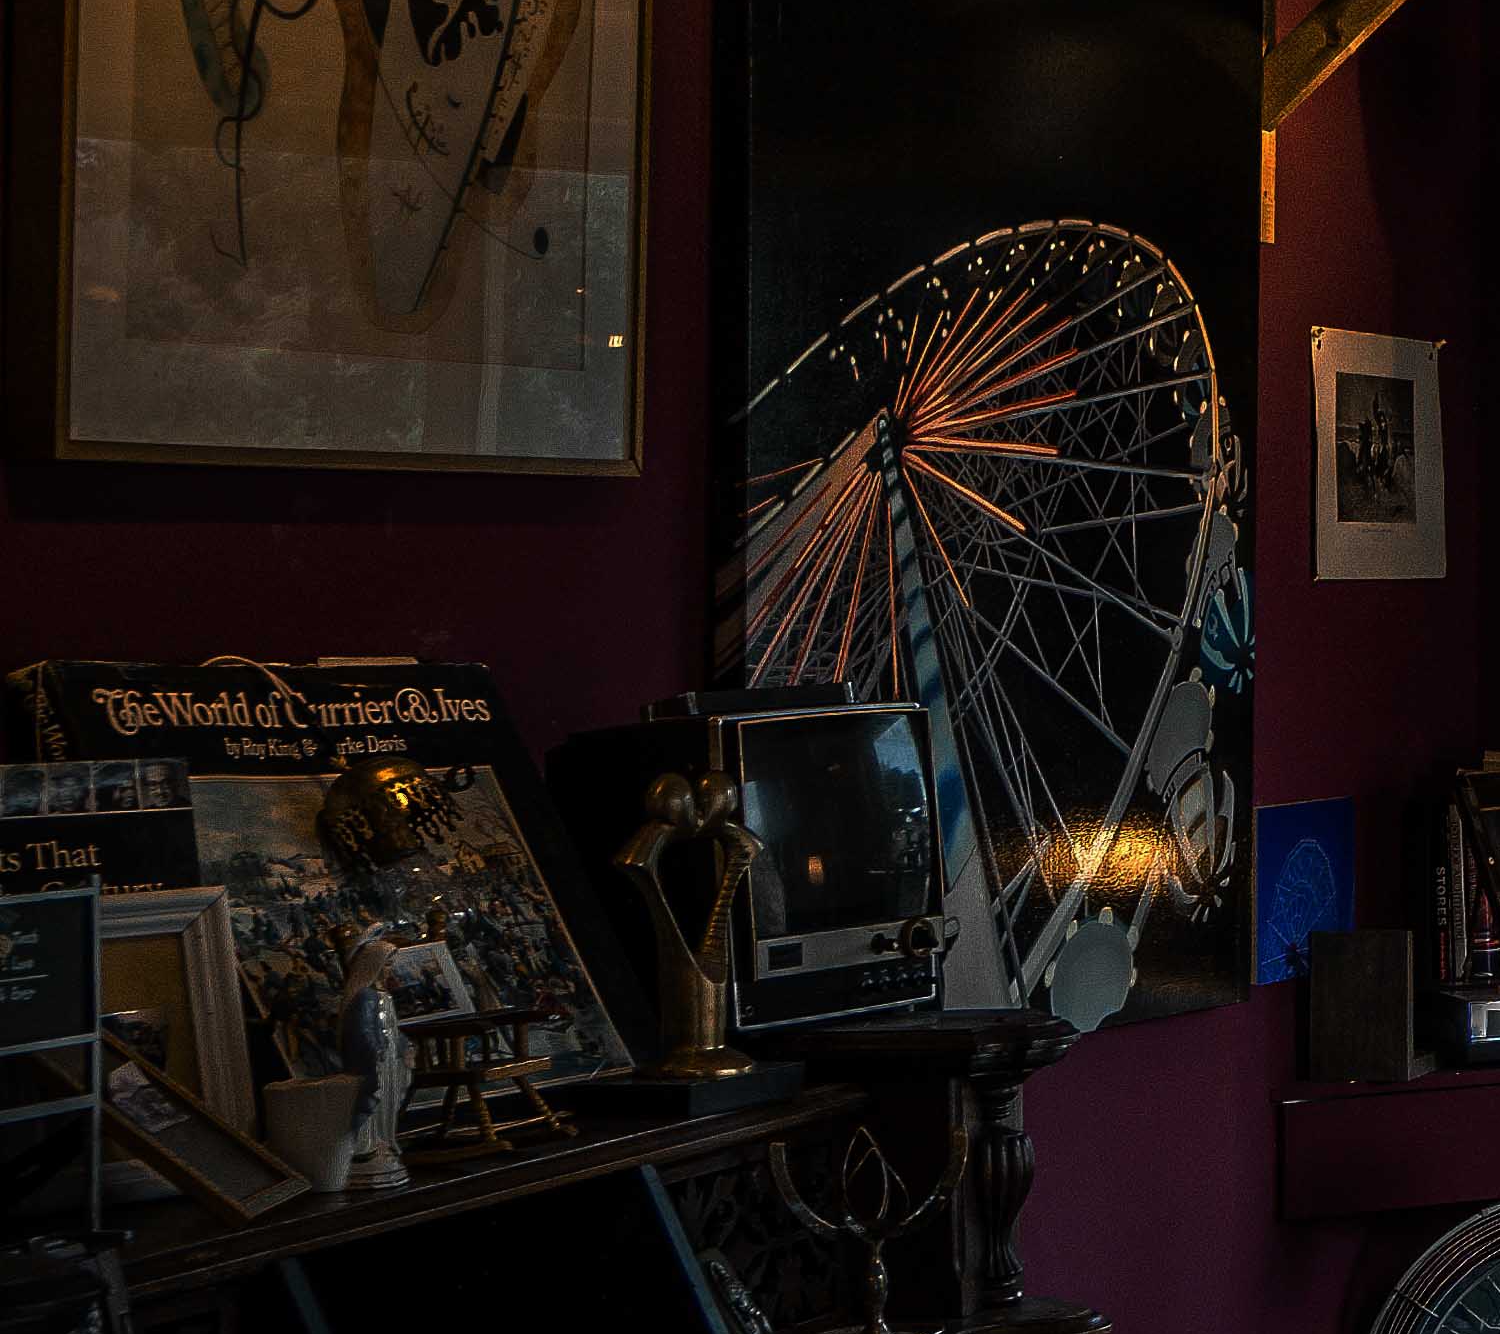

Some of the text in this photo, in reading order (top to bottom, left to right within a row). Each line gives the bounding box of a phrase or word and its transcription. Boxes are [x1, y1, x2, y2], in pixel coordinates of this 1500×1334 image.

[90, 684, 164, 737] The
[154, 690, 254, 729] World
[255, 689, 287, 729] of
[432, 687, 493, 725] Ives
[222, 735, 240, 760] by
[240, 736, 266, 760] Roy
[365, 733, 408, 754] Davis
[26, 839, 102, 872] That
[1436, 866, 1448, 927] STORES
